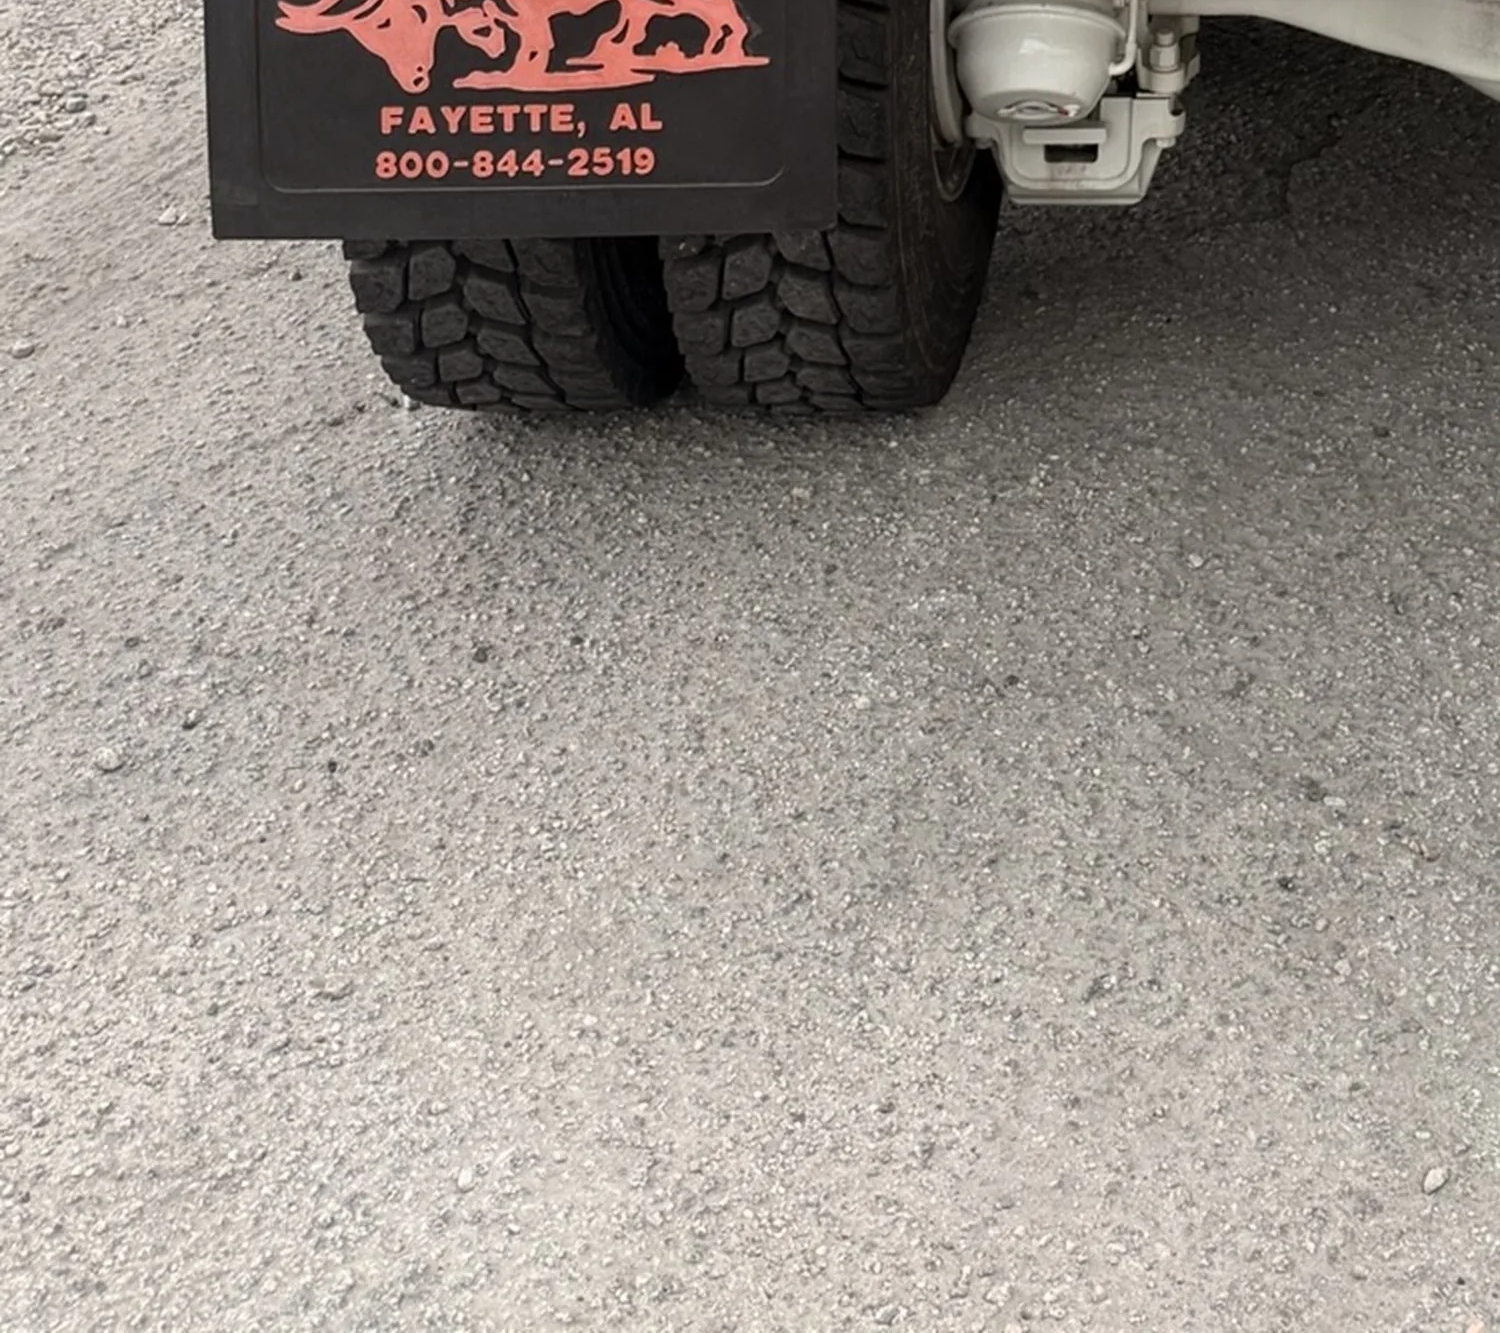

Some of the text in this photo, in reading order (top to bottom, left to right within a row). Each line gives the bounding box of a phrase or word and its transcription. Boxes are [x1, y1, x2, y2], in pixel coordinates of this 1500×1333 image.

[380, 103, 663, 137] FAYETTE, AL
[374, 146, 657, 179] 800-844-2519
